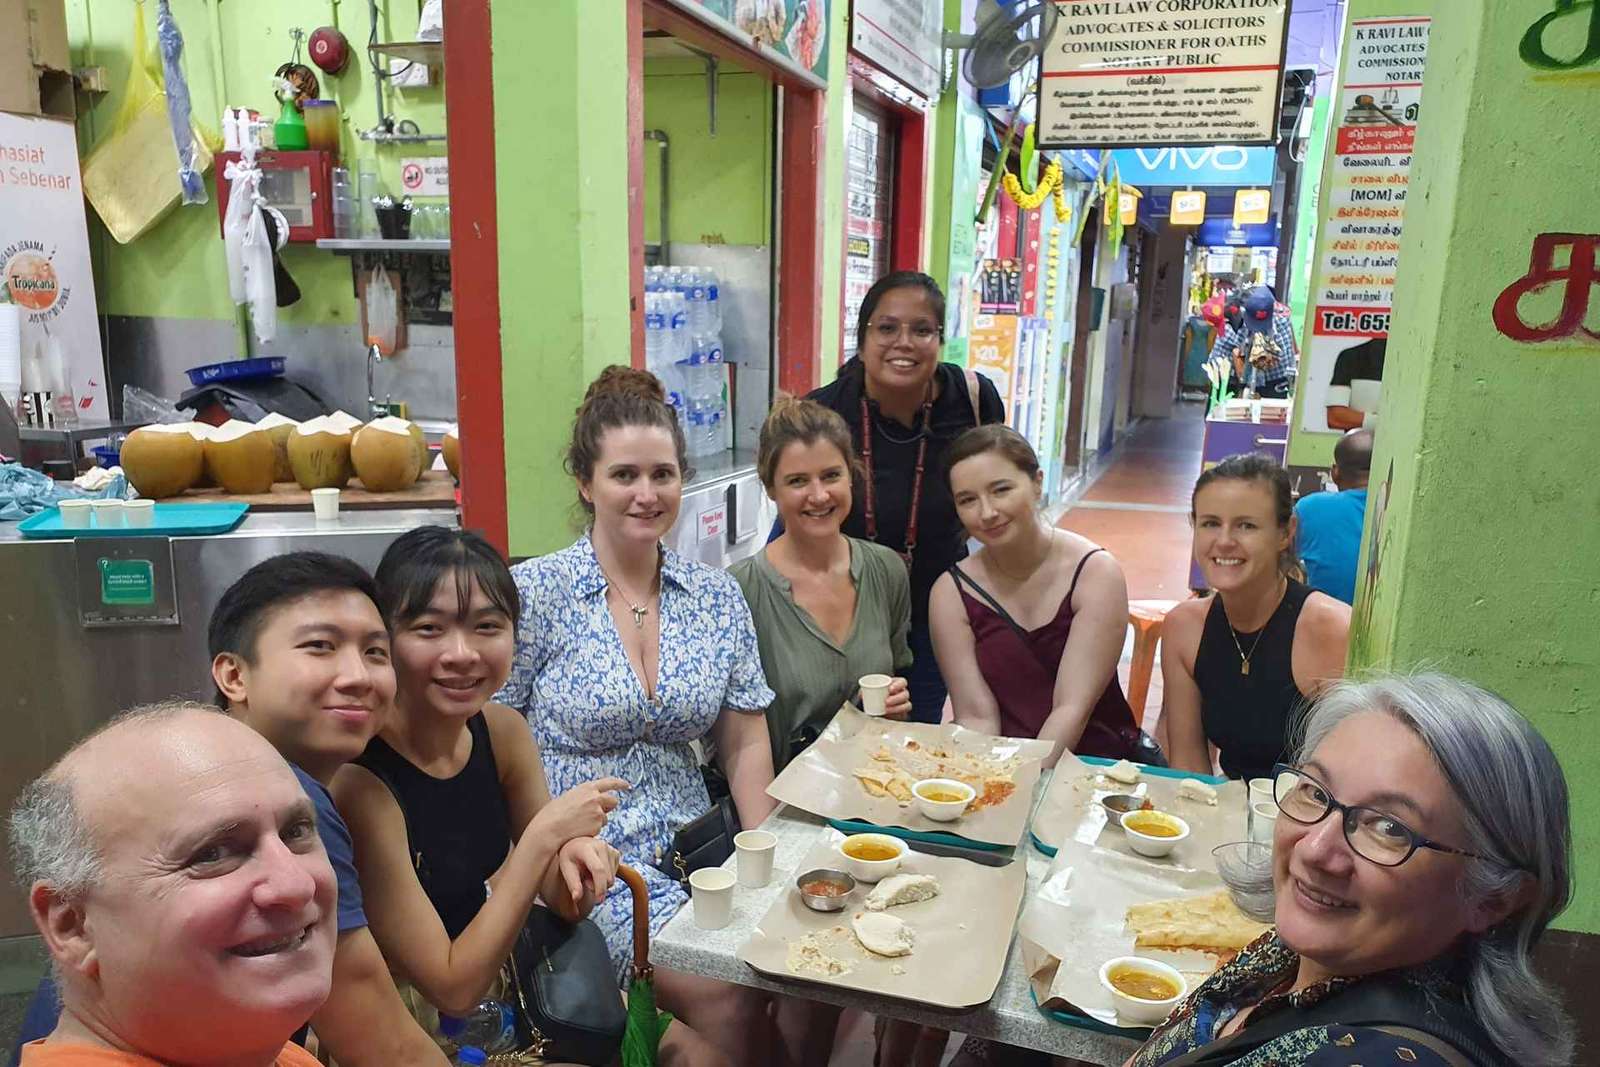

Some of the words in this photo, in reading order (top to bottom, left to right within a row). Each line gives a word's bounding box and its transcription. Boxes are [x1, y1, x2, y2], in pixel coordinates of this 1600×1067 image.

[1071, 3, 1111, 17] RAVI
[1114, 1, 1153, 15] LAW
[1156, 0, 1280, 13] CORPORATION
[1065, 21, 1155, 36] ADVOCATES
[1157, 19, 1169, 32] &
[1173, 15, 1266, 31] SOLICITORS
[1356, 29, 1365, 40] K
[1367, 27, 1396, 40] RAVI
[1398, 26, 1425, 39] LAW
[1061, 38, 1177, 54] COMMISSIONER
[1180, 36, 1211, 49] FOR
[1214, 34, 1267, 48] OATHS
[1360, 43, 1426, 55] ADVOCATES
[1101, 55, 1161, 68] NOTARY
[1167, 52, 1222, 66] PUBLIC
[1385, 71, 1425, 81] NOTAR
[9, 166, 71, 190] Sebenar
[1350, 188, 1392, 202] [MOM]
[11, 275, 56, 291] Tropicana
[1323, 312, 1356, 330] Tel:
